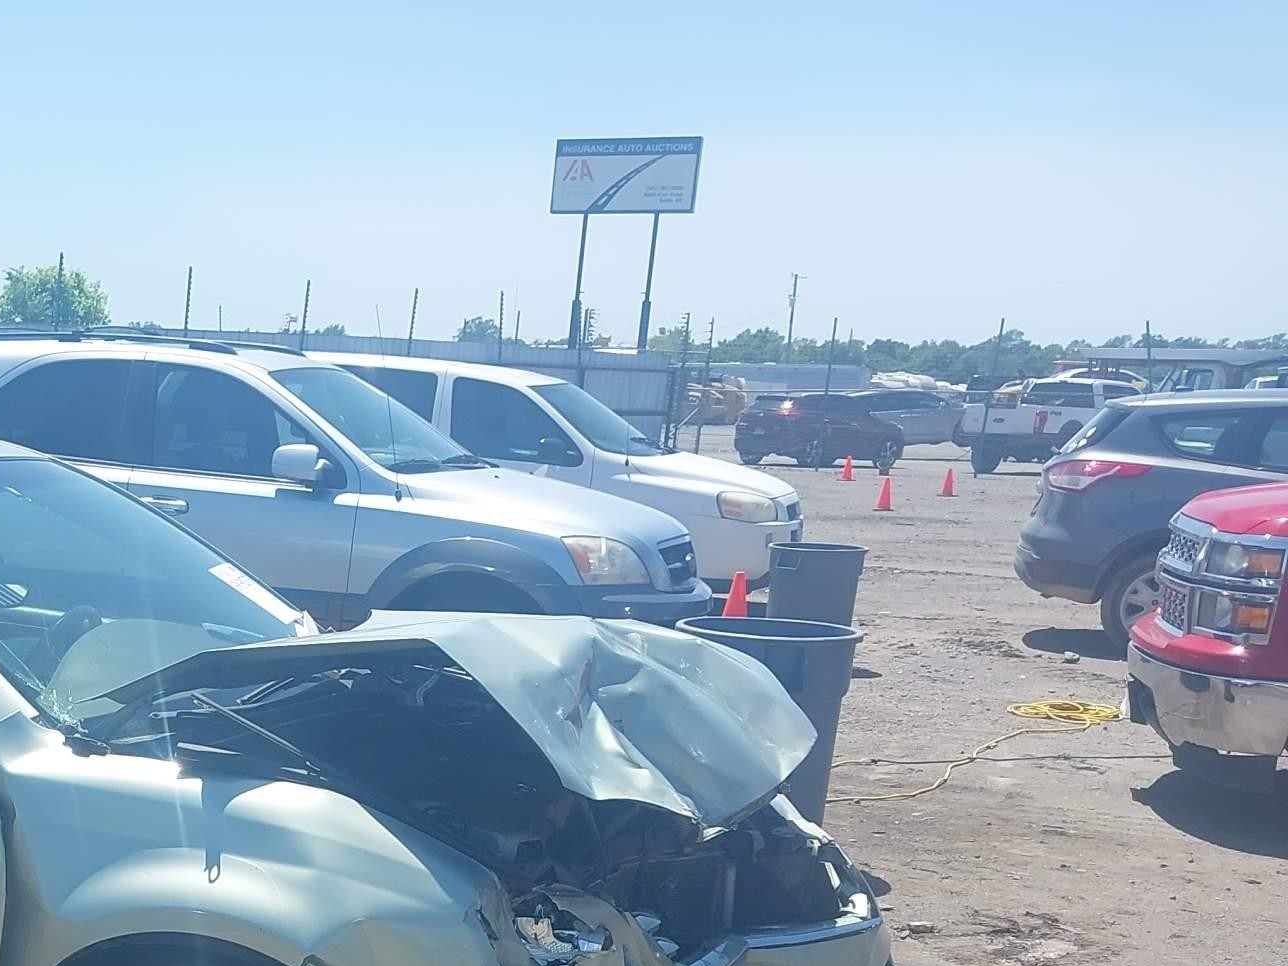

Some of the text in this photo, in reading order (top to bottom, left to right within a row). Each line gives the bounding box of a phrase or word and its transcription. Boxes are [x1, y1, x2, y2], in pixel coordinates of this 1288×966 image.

[562, 143, 694, 153] INSURANCE AUTO AUCTIONS
